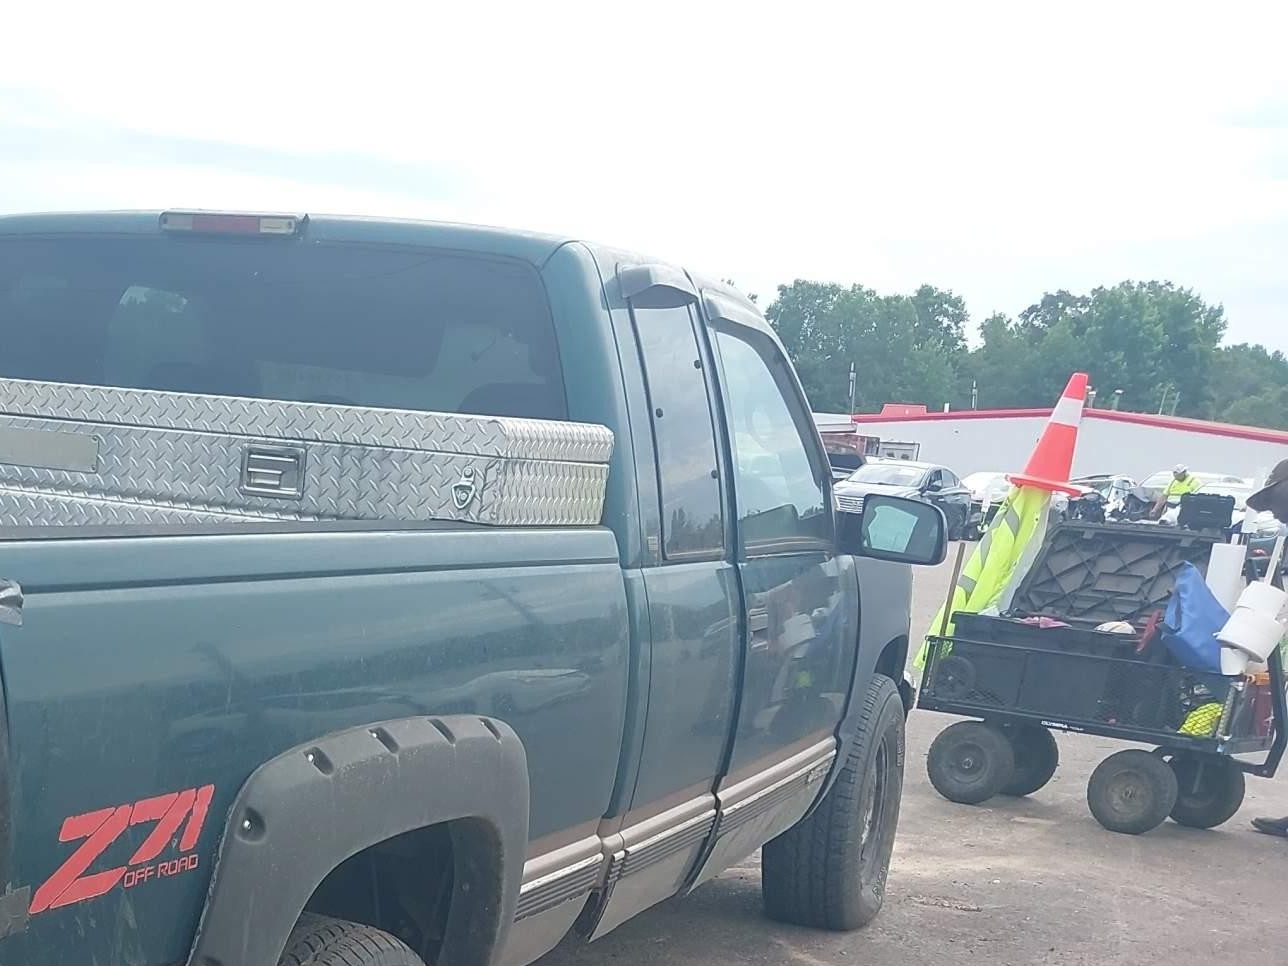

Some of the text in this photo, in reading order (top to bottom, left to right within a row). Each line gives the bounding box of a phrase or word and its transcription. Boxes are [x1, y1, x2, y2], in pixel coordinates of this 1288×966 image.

[28, 783, 216, 915] Z71
[123, 853, 199, 889] OFF ROAD
